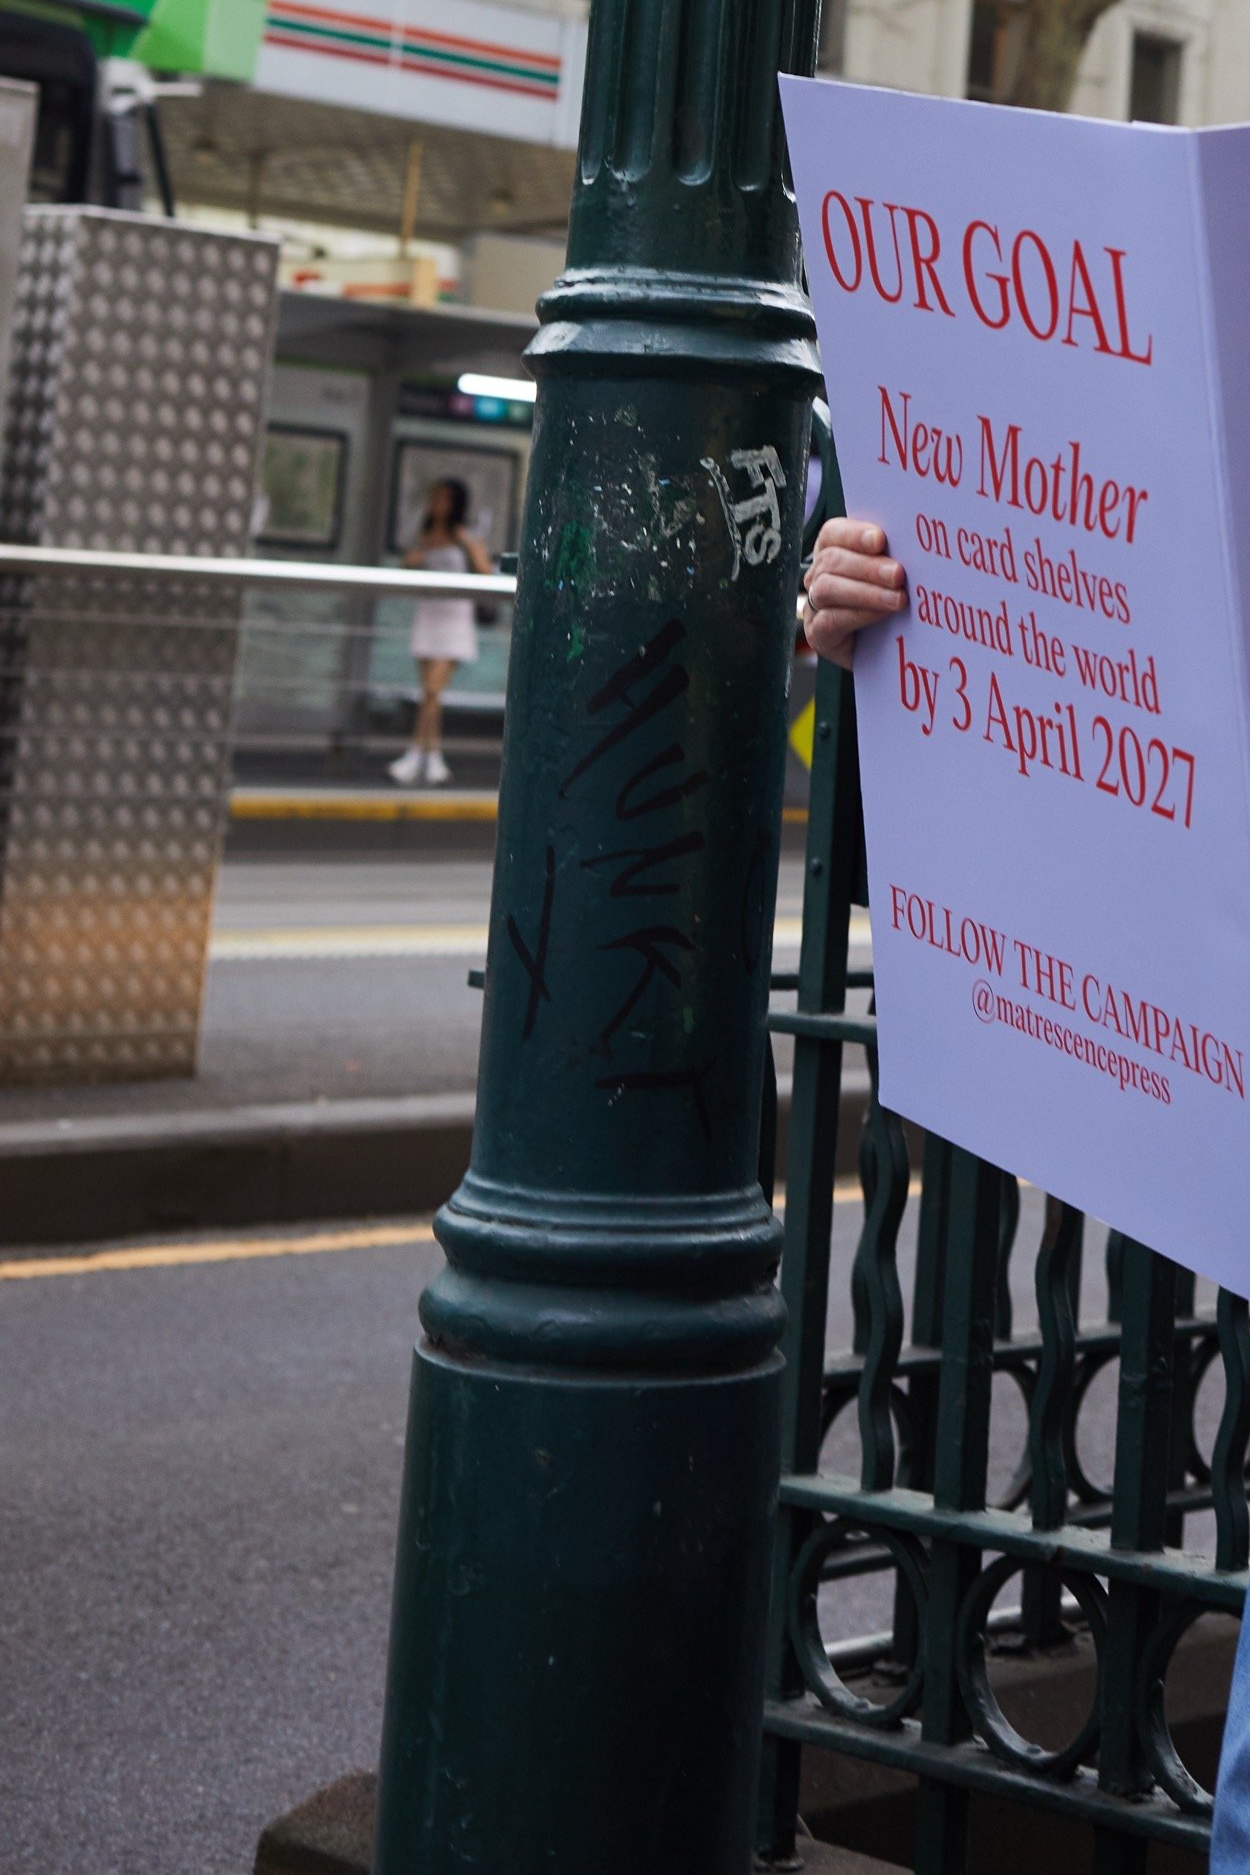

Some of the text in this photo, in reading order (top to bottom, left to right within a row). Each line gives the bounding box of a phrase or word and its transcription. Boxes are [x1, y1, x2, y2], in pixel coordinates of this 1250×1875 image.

[821, 189, 1153, 367] OUR GOAL
[876, 385, 1149, 545] New Mother
[915, 511, 1131, 626] on card shelves
[915, 585, 1162, 716] around the world
[896, 635, 1196, 830] by 3 April 2027
[888, 883, 1246, 1101] FOLLOW THE CAMPAIGN
[970, 977, 1173, 1107] @matrescencepress
